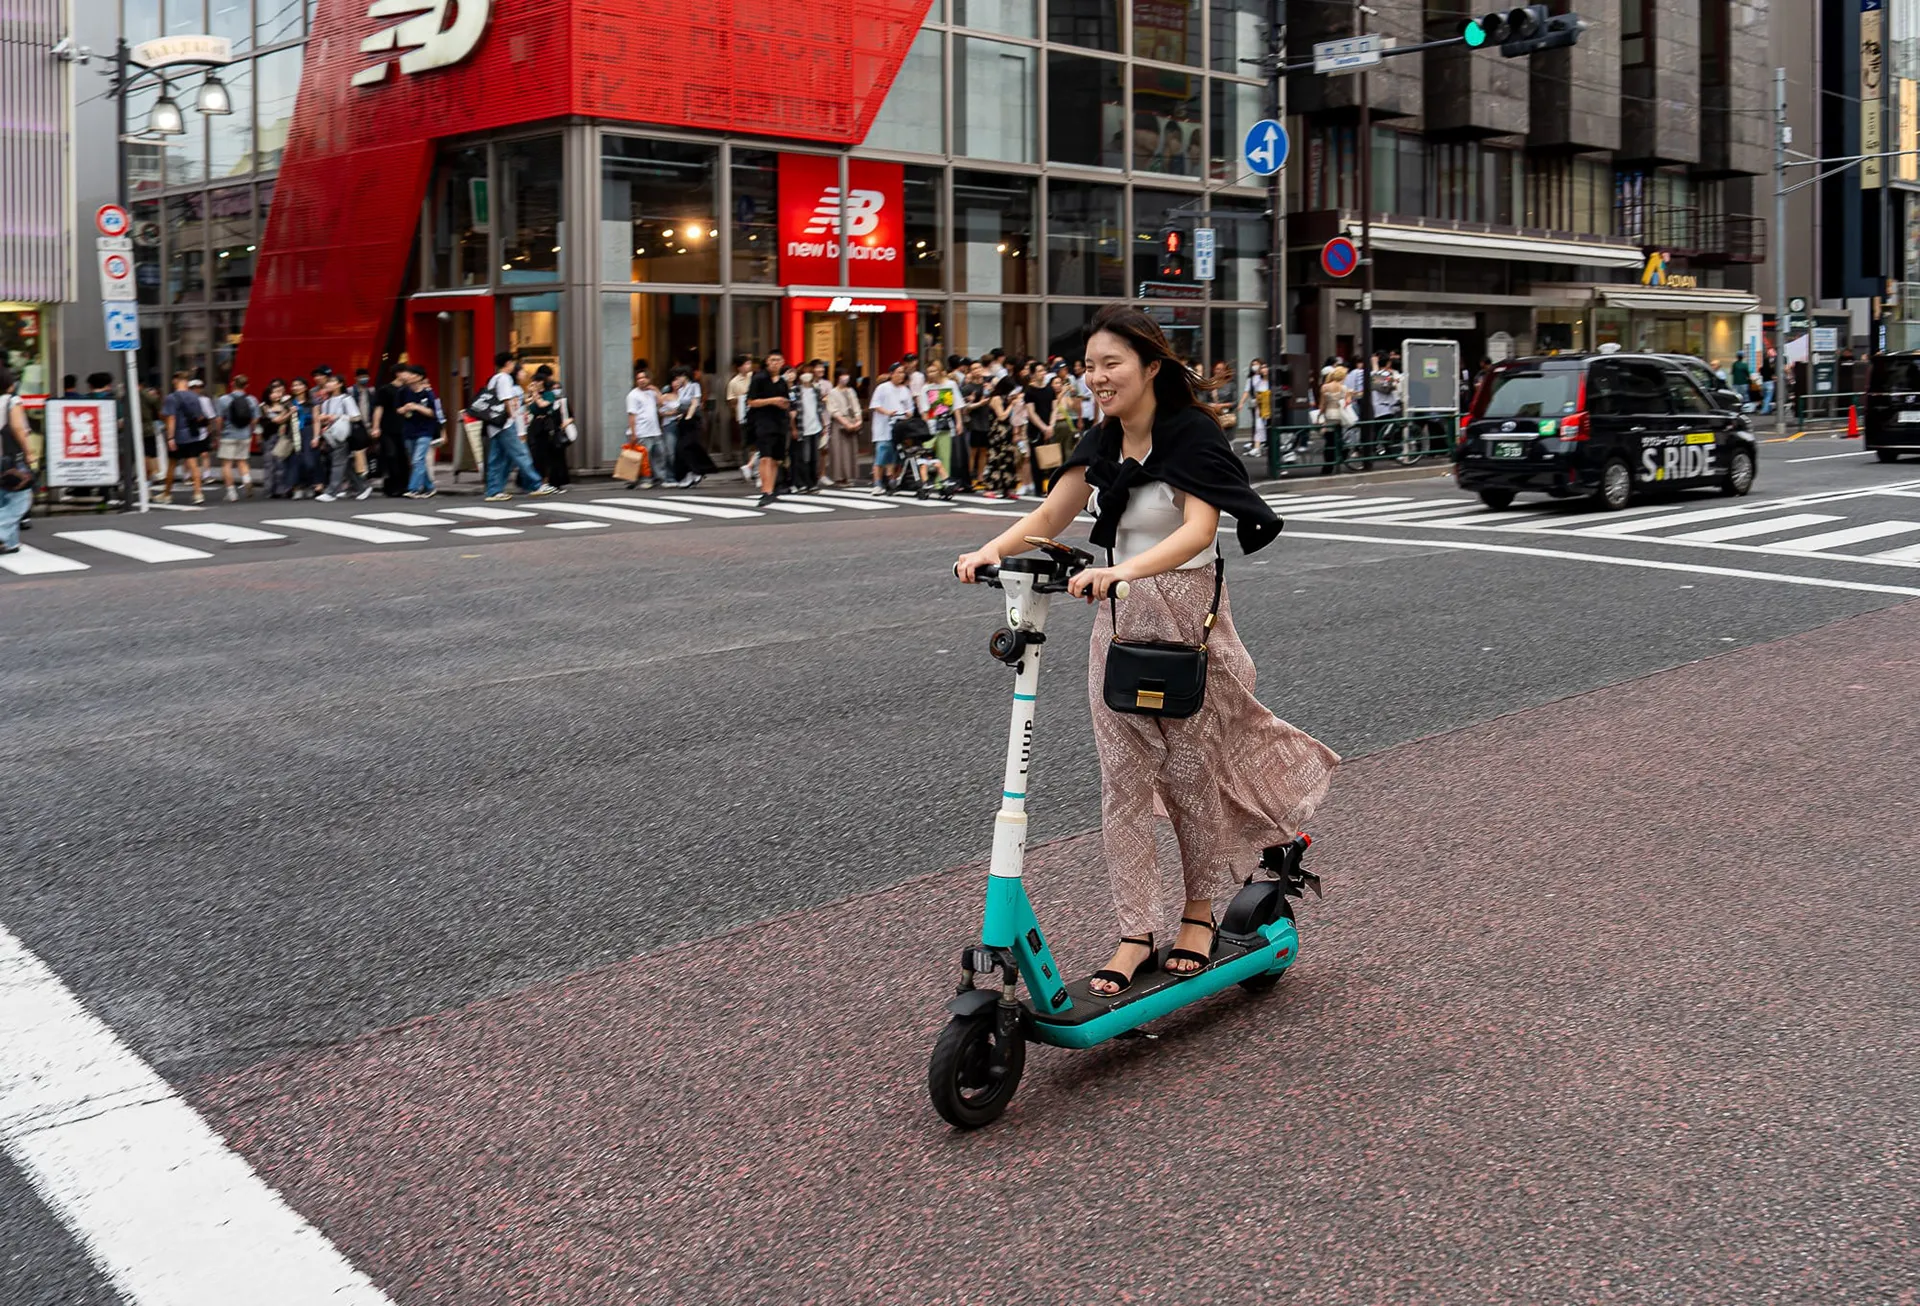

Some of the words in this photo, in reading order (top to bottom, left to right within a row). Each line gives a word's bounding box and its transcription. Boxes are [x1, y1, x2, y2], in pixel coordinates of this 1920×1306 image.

[787, 241, 825, 258] new
[826, 240, 897, 262] blance
[1641, 443, 1717, 482] S.RIDE
[1019, 719, 1033, 774] LUUP
